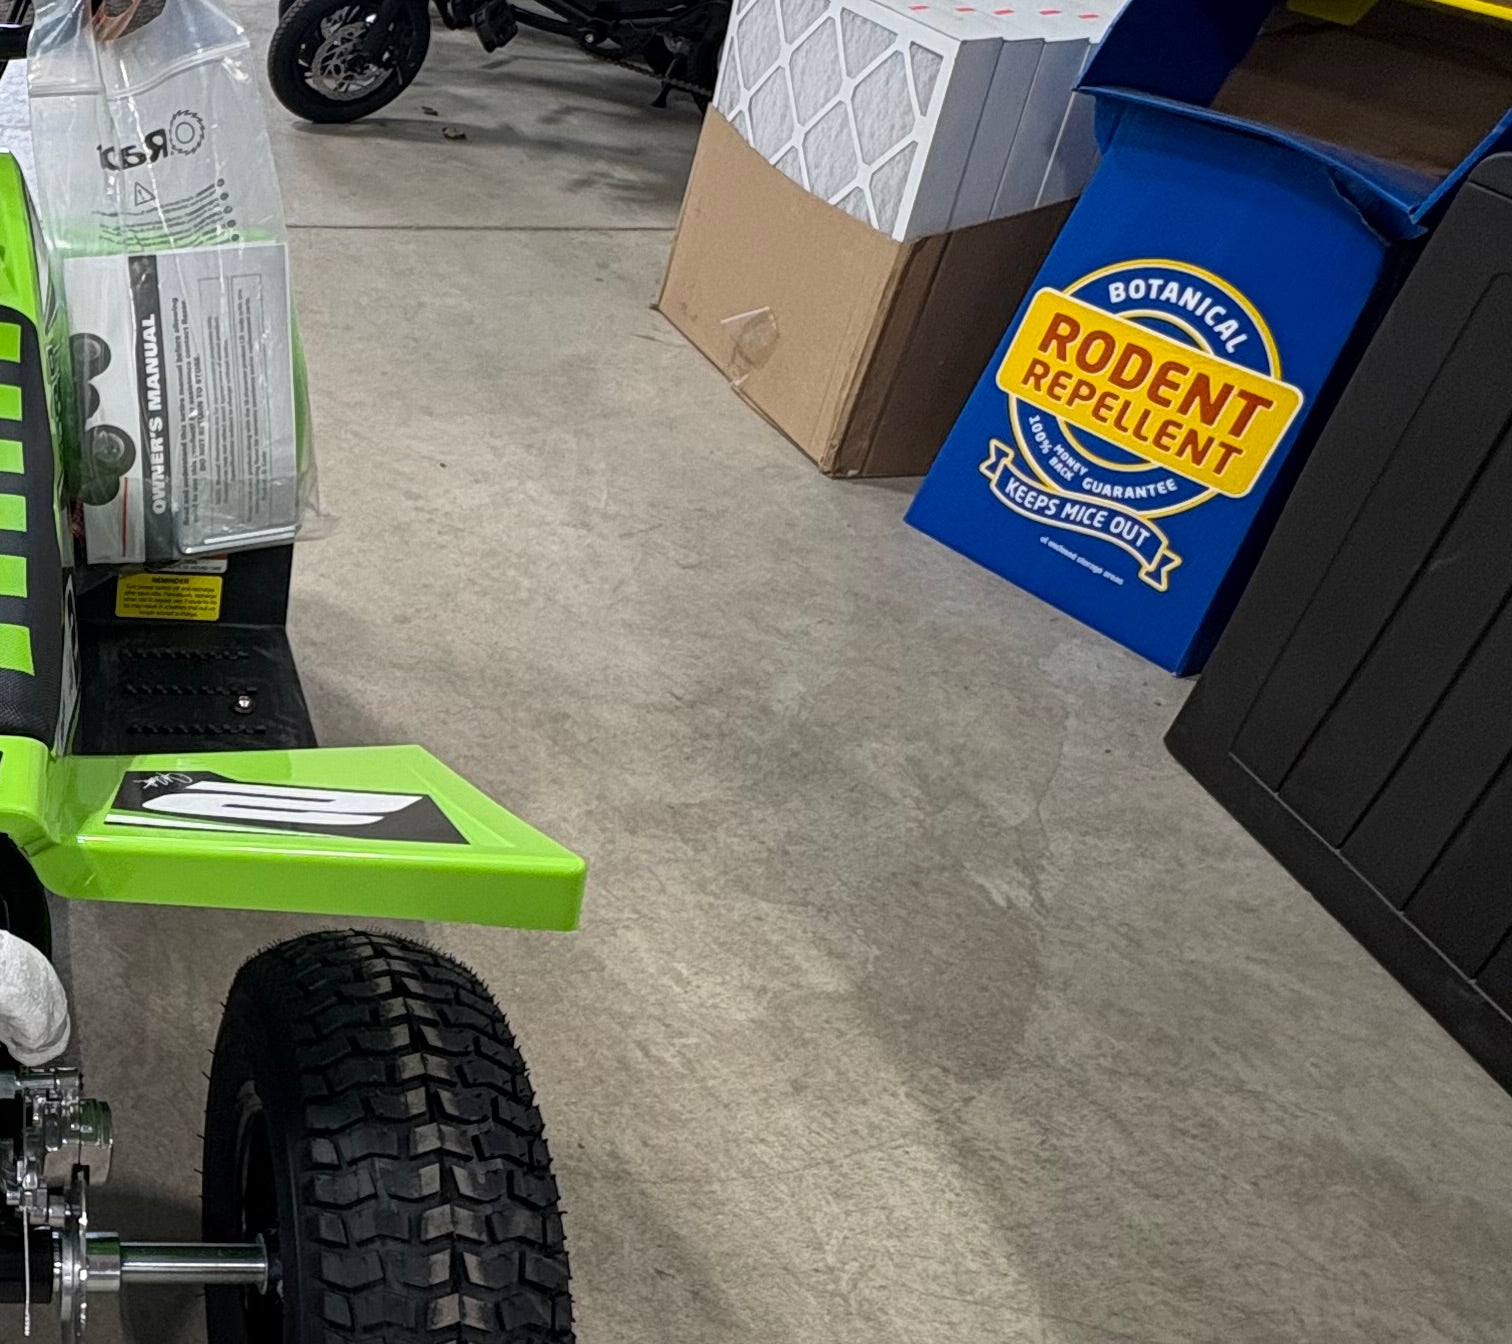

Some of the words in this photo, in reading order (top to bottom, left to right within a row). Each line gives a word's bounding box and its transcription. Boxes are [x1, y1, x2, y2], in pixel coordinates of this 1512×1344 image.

[171, 296, 181, 332] allowing
[1108, 278, 1248, 354] BOTANICAL
[141, 313, 161, 410] MANUAL
[174, 334, 182, 361] before
[196, 386, 203, 398] TO
[1038, 311, 1274, 438] RODENT
[1021, 358, 1243, 475] REPELLENT
[1028, 415, 1052, 455] 100%
[149, 416, 167, 514] OWNER'S
[200, 457, 206, 470] DO
[1049, 458, 1075, 482] BACK
[1052, 444, 1088, 476] MONEY
[1082, 477, 1178, 499] GUARANTEE
[1005, 476, 1060, 516] KEEPS
[1060, 501, 1109, 528] MICE
[1109, 516, 1152, 548] OUT
[1076, 555, 1104, 575] storage
